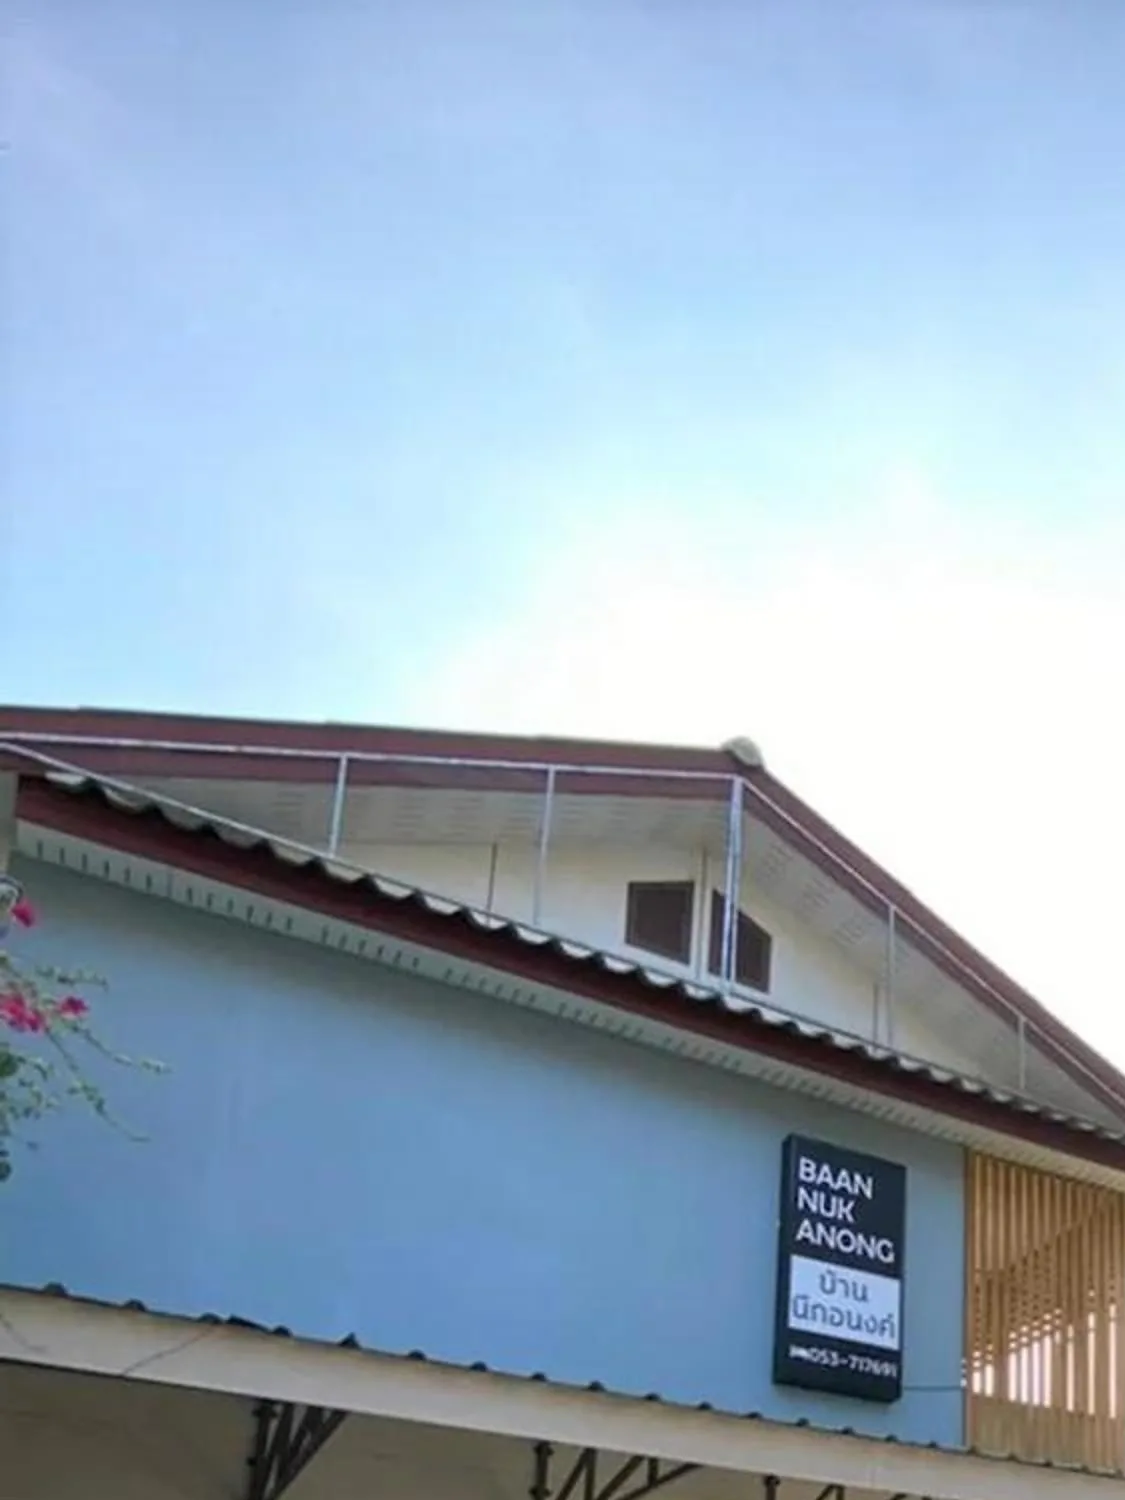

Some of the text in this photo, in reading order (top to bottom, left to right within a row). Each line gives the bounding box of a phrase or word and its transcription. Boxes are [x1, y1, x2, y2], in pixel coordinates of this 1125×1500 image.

[798, 1156, 874, 1200] BAAN
[798, 1186, 856, 1223] NUK
[795, 1218, 895, 1263] ANONG
[819, 1268, 868, 1303] บ้าน
